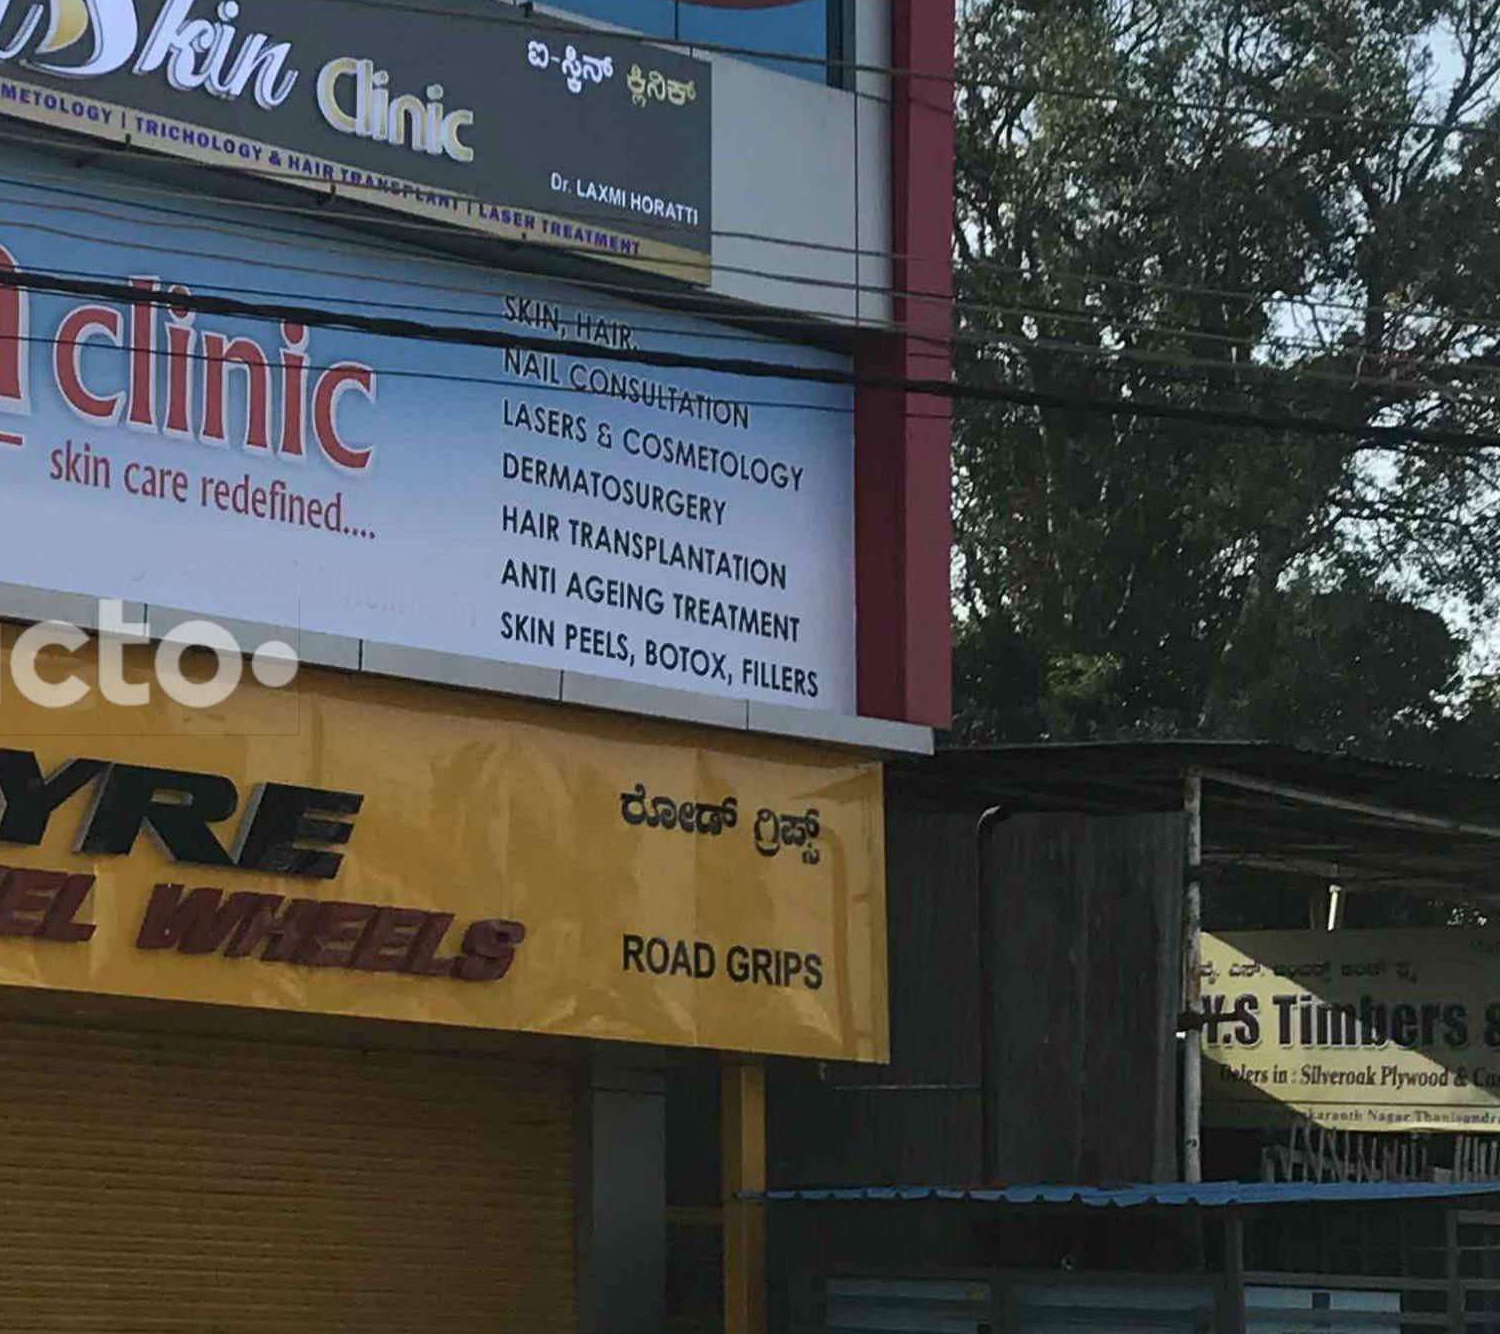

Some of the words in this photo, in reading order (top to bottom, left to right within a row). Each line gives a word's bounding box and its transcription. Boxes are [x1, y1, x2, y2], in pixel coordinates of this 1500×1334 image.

[316, 56, 474, 163] Clinic
[135, 116, 263, 161] TRICHOLOGY
[268, 150, 283, 166] &
[288, 155, 335, 180] HAIR
[340, 168, 460, 210] TRANSPLANT
[479, 203, 537, 230] LASER
[542, 218, 641, 256] TREATMENT
[551, 171, 573, 195] Dr.
[576, 178, 627, 208] LAXMI
[631, 193, 700, 227] HORATTI
[502, 296, 568, 339] SKIN,
[53, 275, 379, 473] clinic
[503, 348, 560, 386] NAIL
[569, 364, 749, 430] CONSULTATION
[49, 440, 111, 491] skin
[124, 457, 189, 504] care
[503, 399, 588, 444] LASERS
[597, 422, 612, 449] &
[623, 428, 804, 492] COSMETOLOGY
[502, 453, 726, 526] DERMATOSURGERY
[502, 505, 559, 542] HAIR
[568, 518, 787, 590] TRANSPLANTATION
[501, 558, 556, 595] ANTI
[566, 572, 664, 616] AGEING
[672, 593, 800, 643] TREATMENT
[501, 611, 555, 647] SKIN
[565, 623, 635, 668] PEELS,
[645, 639, 733, 686] BOTOX,
[741, 658, 819, 698] FILLERS
[136, 882, 526, 982] WHEELS
[622, 933, 716, 979] ROAD
[726, 945, 823, 990] GRIPS
[1272, 993, 1468, 1047] Timbers
[1301, 1064, 1376, 1086] Silveroak
[1381, 1064, 1449, 1090] Plywood
